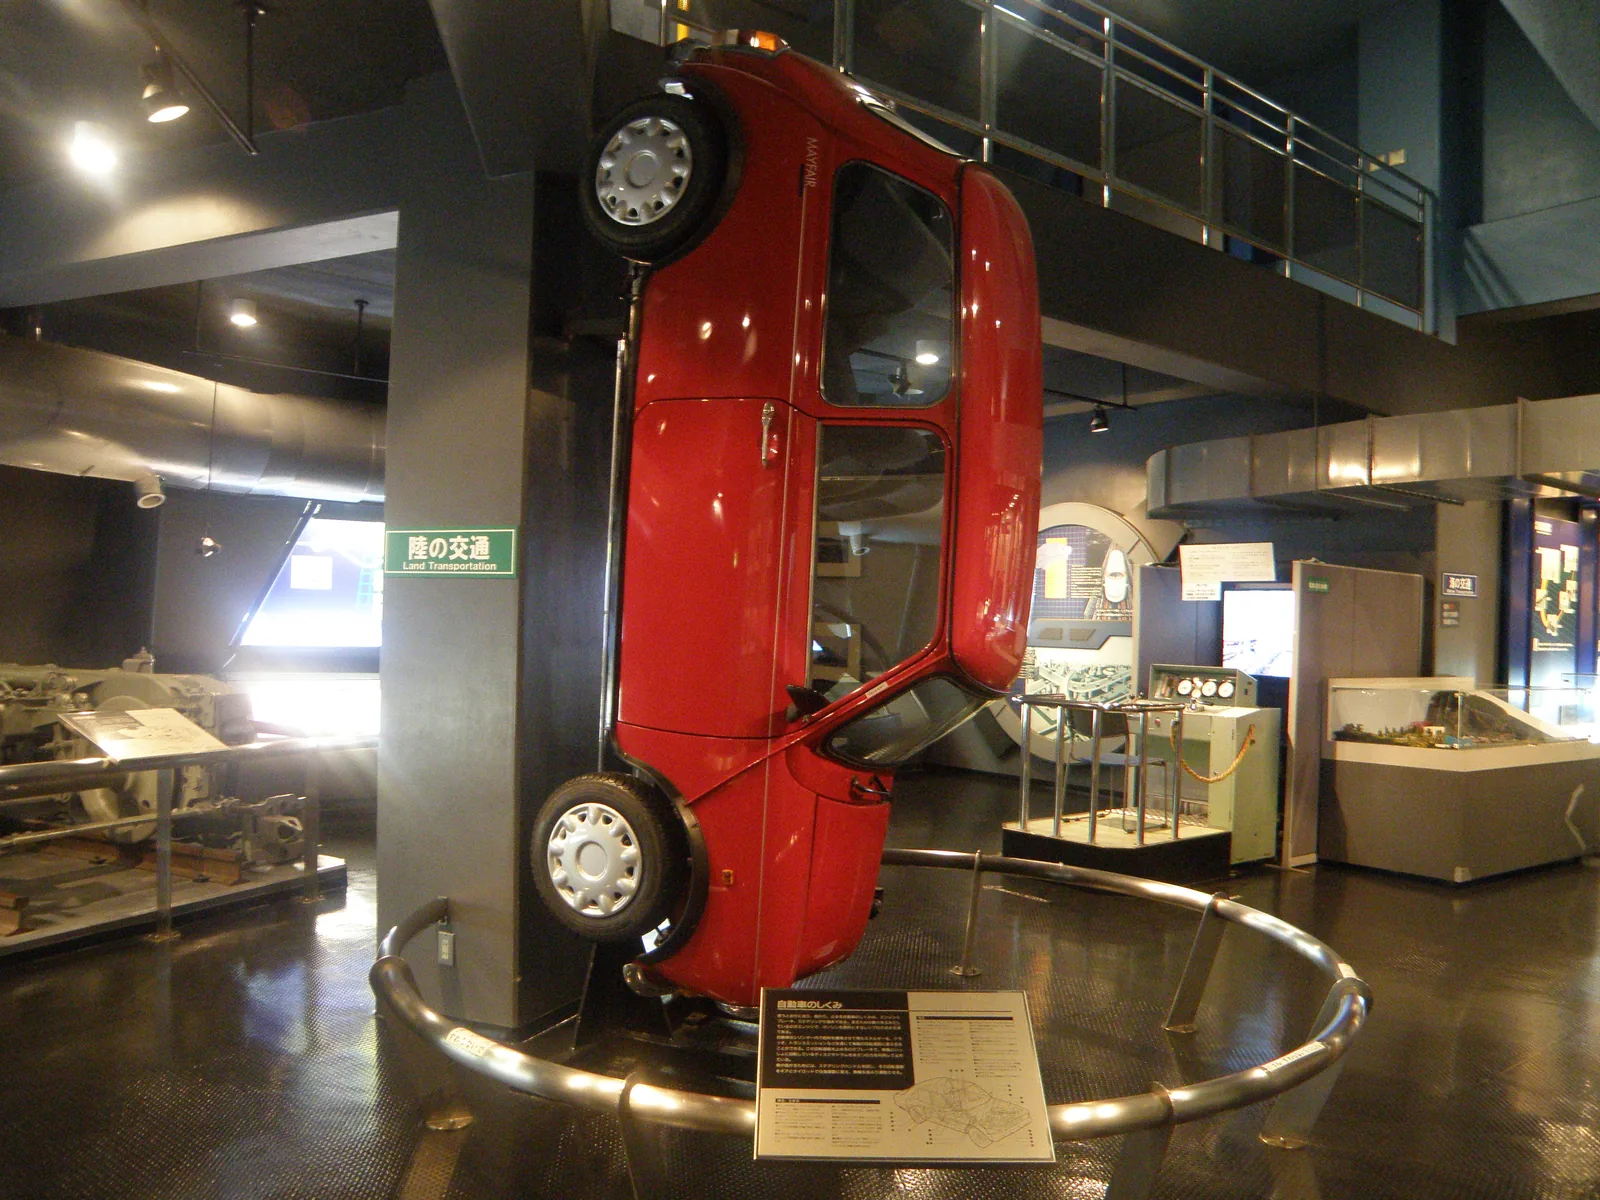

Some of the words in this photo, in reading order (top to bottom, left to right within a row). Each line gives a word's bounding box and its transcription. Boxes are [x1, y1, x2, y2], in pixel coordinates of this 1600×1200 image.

[804, 136, 819, 188] MAYFAIR
[408, 536, 490, 560] 陸の交通
[402, 561, 425, 570] Land
[428, 562, 497, 571] Transportation
[777, 1000, 843, 1009] 自動車のしくみ
